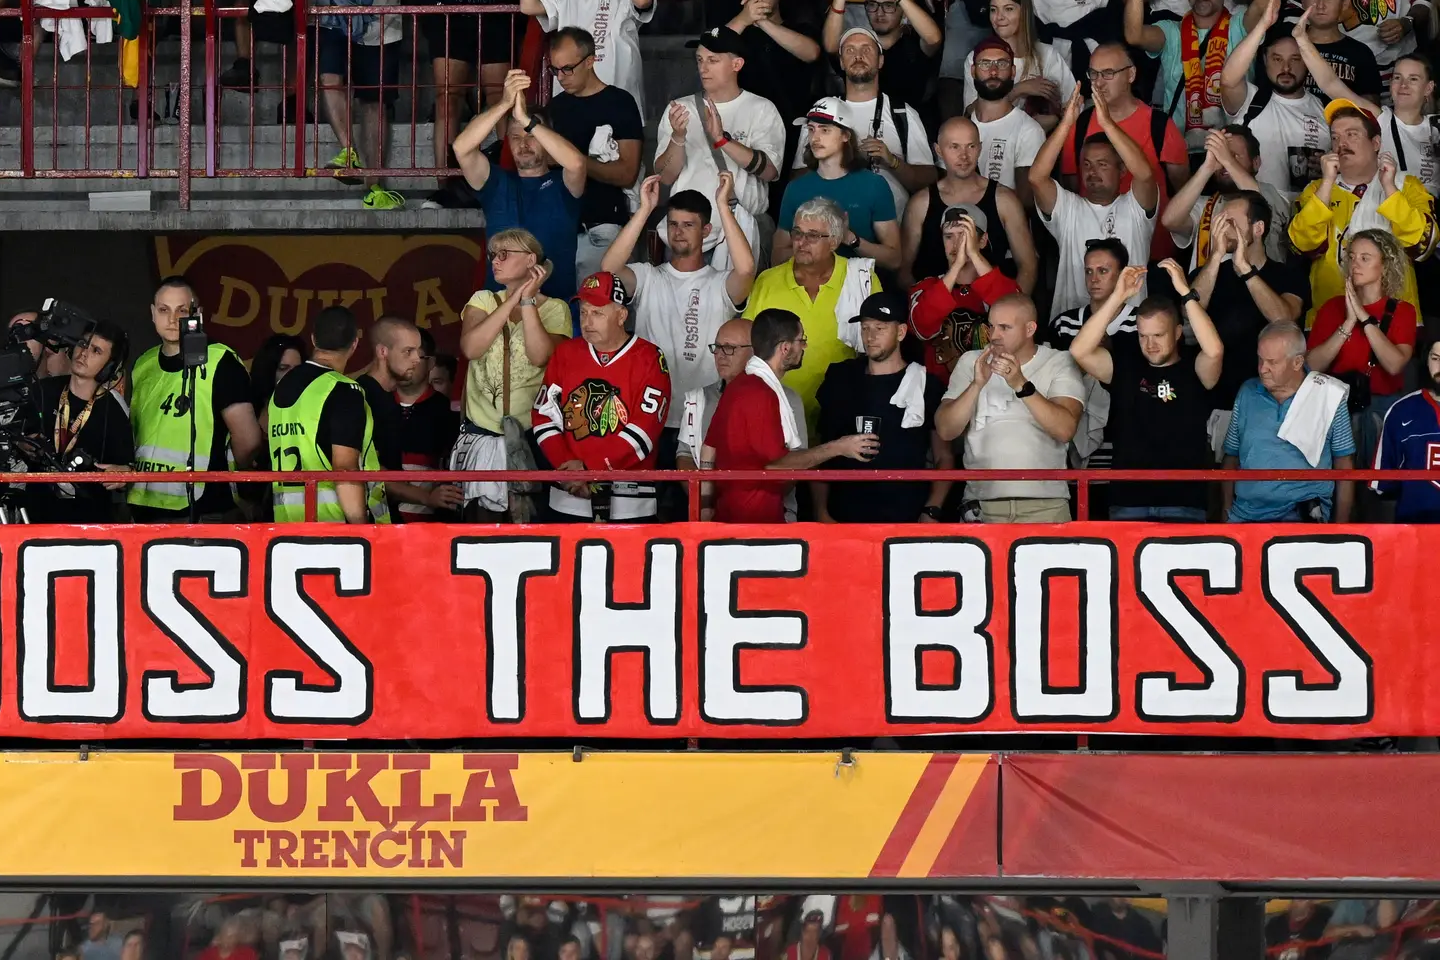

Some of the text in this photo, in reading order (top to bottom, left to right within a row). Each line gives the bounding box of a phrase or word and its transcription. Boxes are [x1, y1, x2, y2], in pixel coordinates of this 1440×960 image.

[592, 12, 609, 52] HOSSA
[685, 307, 699, 350] HOSSA
[1157, 383, 1171, 399] 81
[451, 536, 808, 726] THE
[883, 535, 1373, 725] BOSS
[173, 754, 528, 822] DUKLA
[233, 816, 467, 870] TRENČÍN
